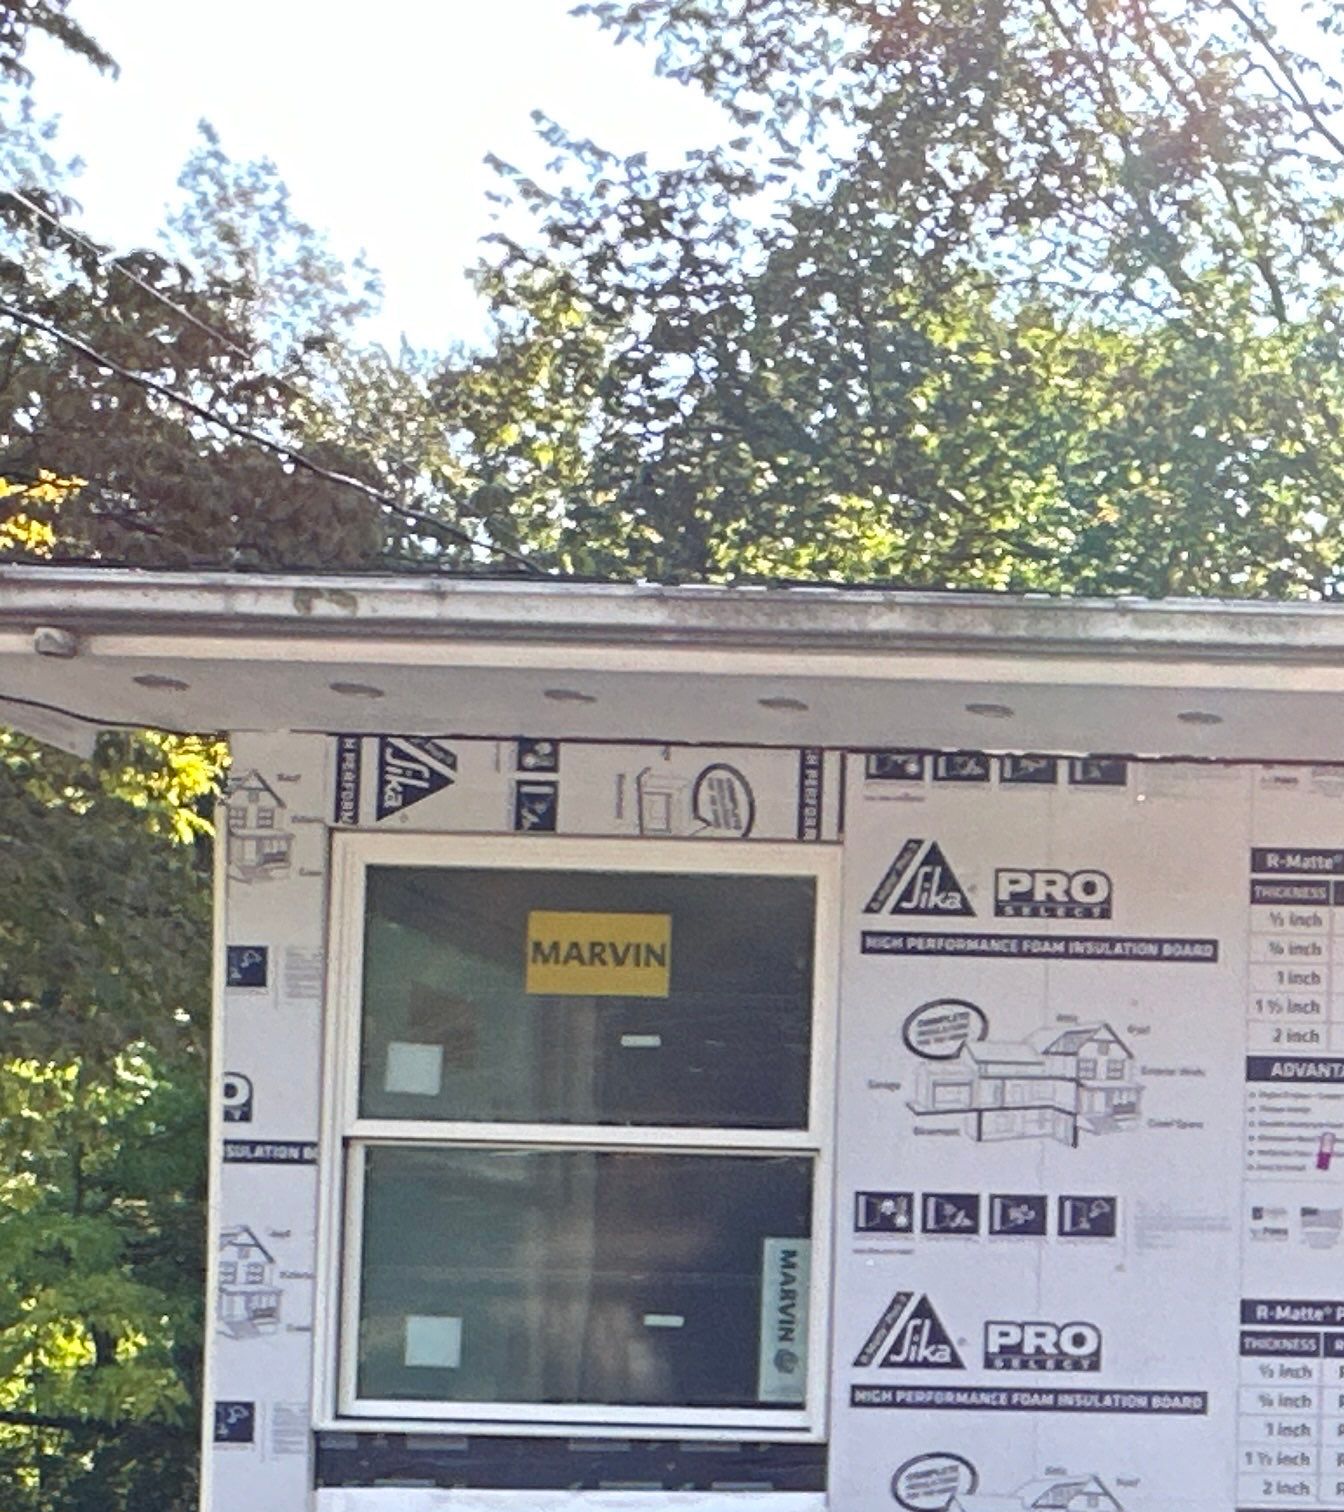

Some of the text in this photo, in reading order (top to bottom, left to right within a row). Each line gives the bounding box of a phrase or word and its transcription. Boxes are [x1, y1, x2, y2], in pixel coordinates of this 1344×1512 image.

[384, 747, 431, 809] Sika
[901, 865, 962, 910] Sika
[998, 872, 1109, 904] PRO
[531, 940, 667, 968] MARVIN
[777, 1249, 797, 1342] MARVIN
[891, 1318, 951, 1362] Sika
[987, 1324, 1099, 1357] PRO
